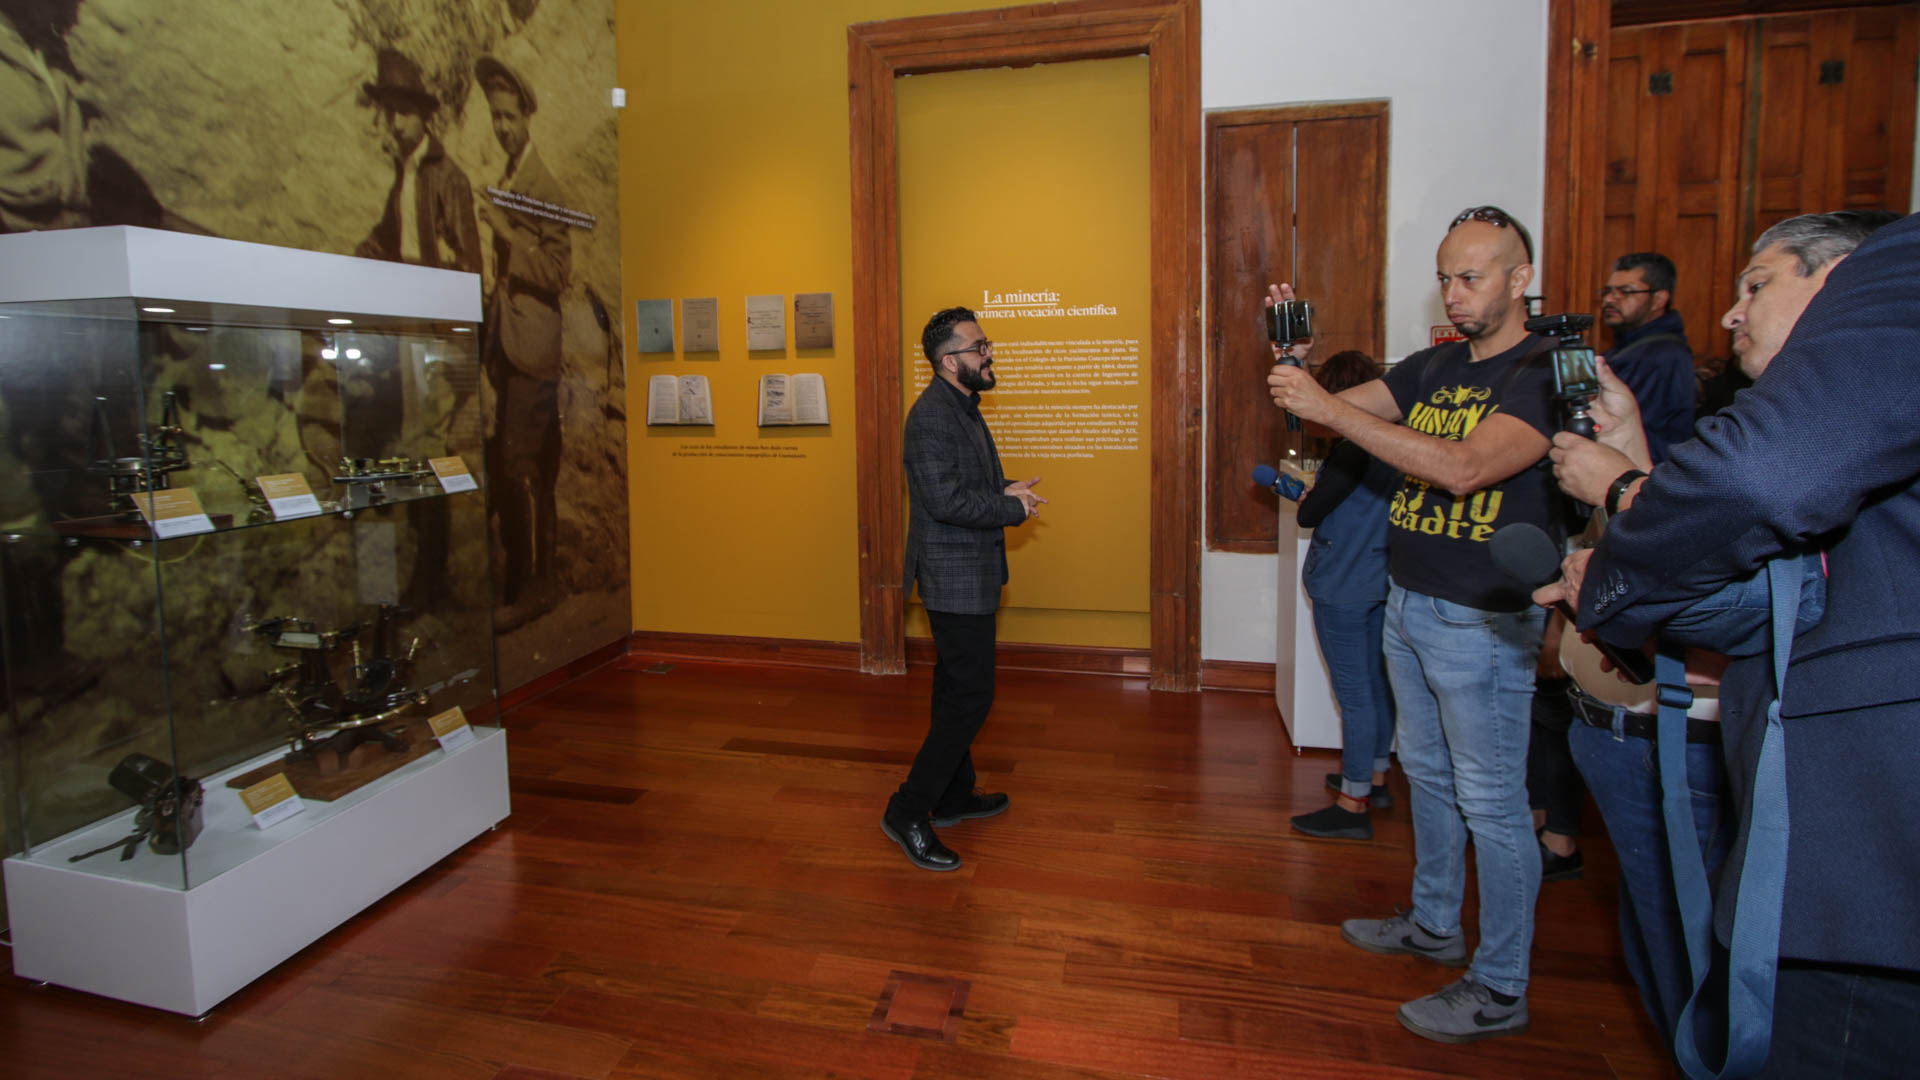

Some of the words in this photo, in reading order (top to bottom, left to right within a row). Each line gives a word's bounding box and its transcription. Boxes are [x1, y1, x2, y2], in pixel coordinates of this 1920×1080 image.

[984, 290, 1002, 304] La
[1005, 289, 1060, 303] minería:
[1018, 306, 1064, 318] vocación
[1067, 304, 1117, 317] científica
